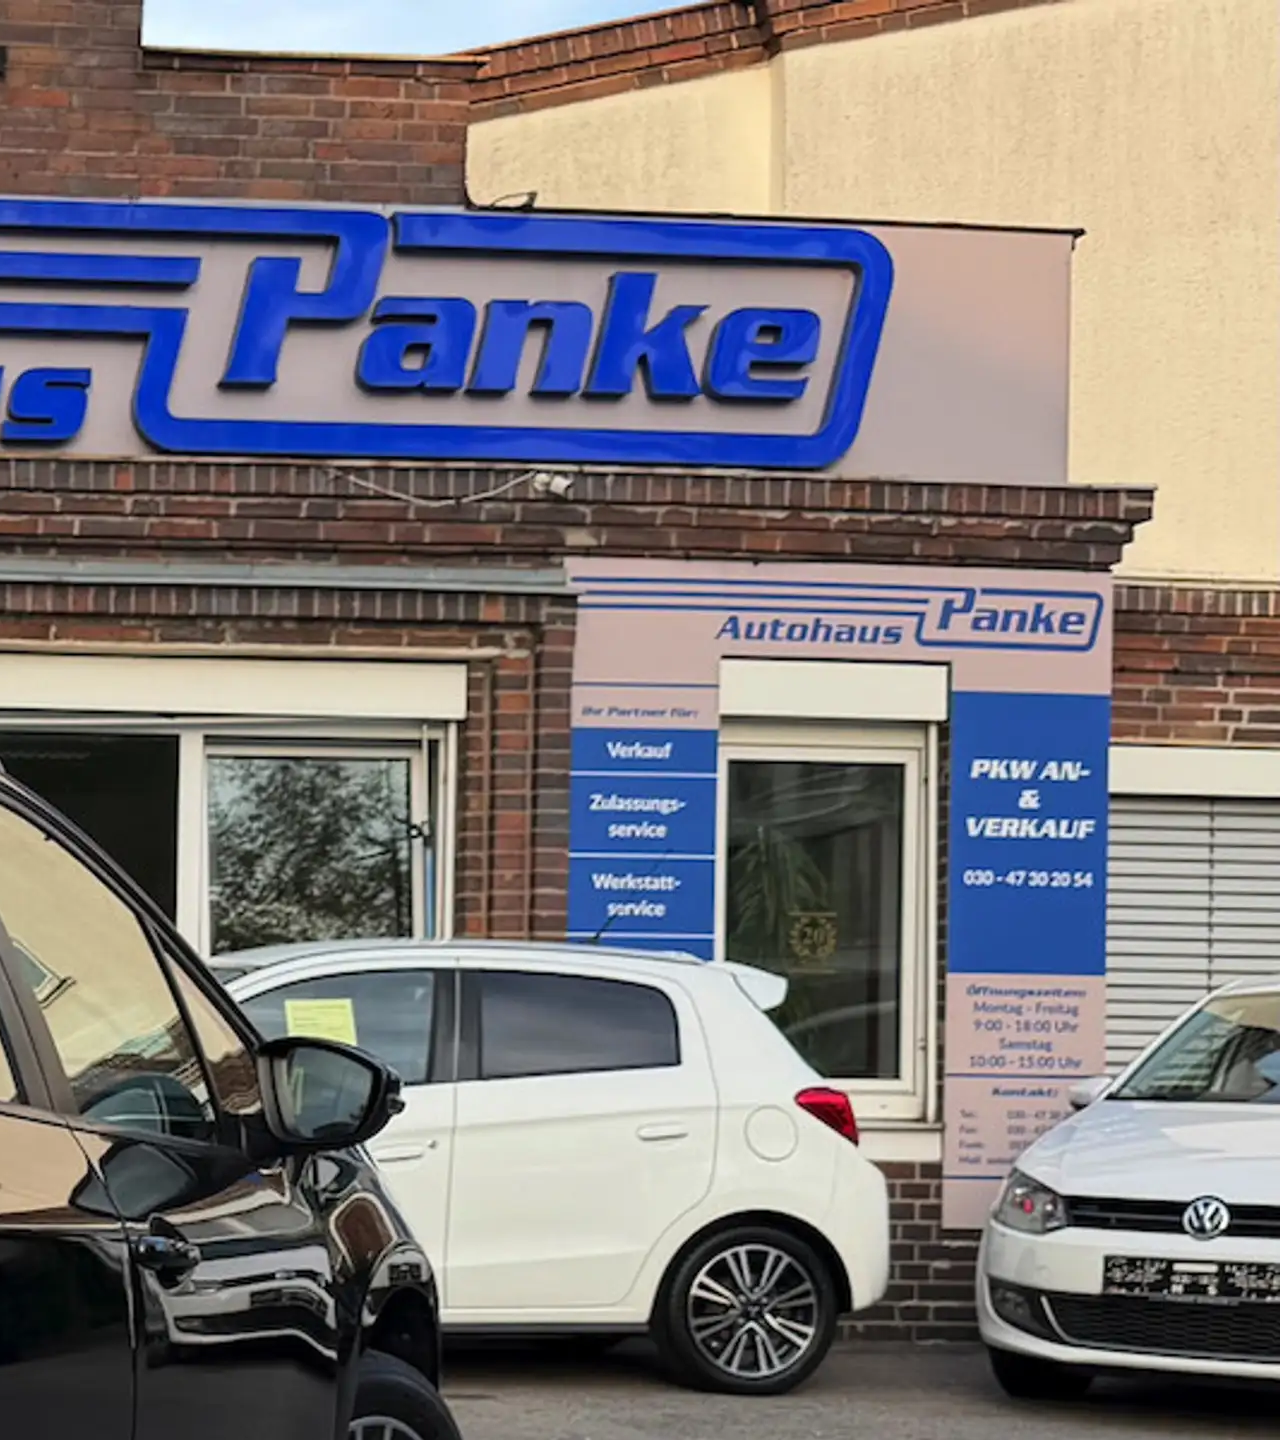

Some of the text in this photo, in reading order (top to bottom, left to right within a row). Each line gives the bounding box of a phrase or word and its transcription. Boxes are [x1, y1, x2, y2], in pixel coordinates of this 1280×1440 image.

[217, 213, 824, 401] Panke
[714, 588, 1086, 646] Autohaus Panke
[606, 741, 673, 759] Verkauf
[970, 758, 1092, 782] PKW AN-
[590, 793, 687, 815] Zulassungs-
[1018, 789, 1041, 810] &
[608, 821, 668, 839] service
[965, 816, 1097, 840] VERKAUF
[591, 872, 682, 892] Werkstatt-
[962, 868, 995, 887] 030
[1005, 869, 1027, 888] 47
[1027, 870, 1050, 888] 30
[1050, 870, 1071, 889] 20
[1073, 871, 1094, 889] 54
[607, 900, 667, 918] service
[973, 1001, 1023, 1017] Montag
[1035, 1002, 1080, 1018] Freitag
[1054, 1020, 1080, 1033] Uhr
[998, 1037, 1053, 1053] Samstag
[1058, 1056, 1083, 1069] Uhr
